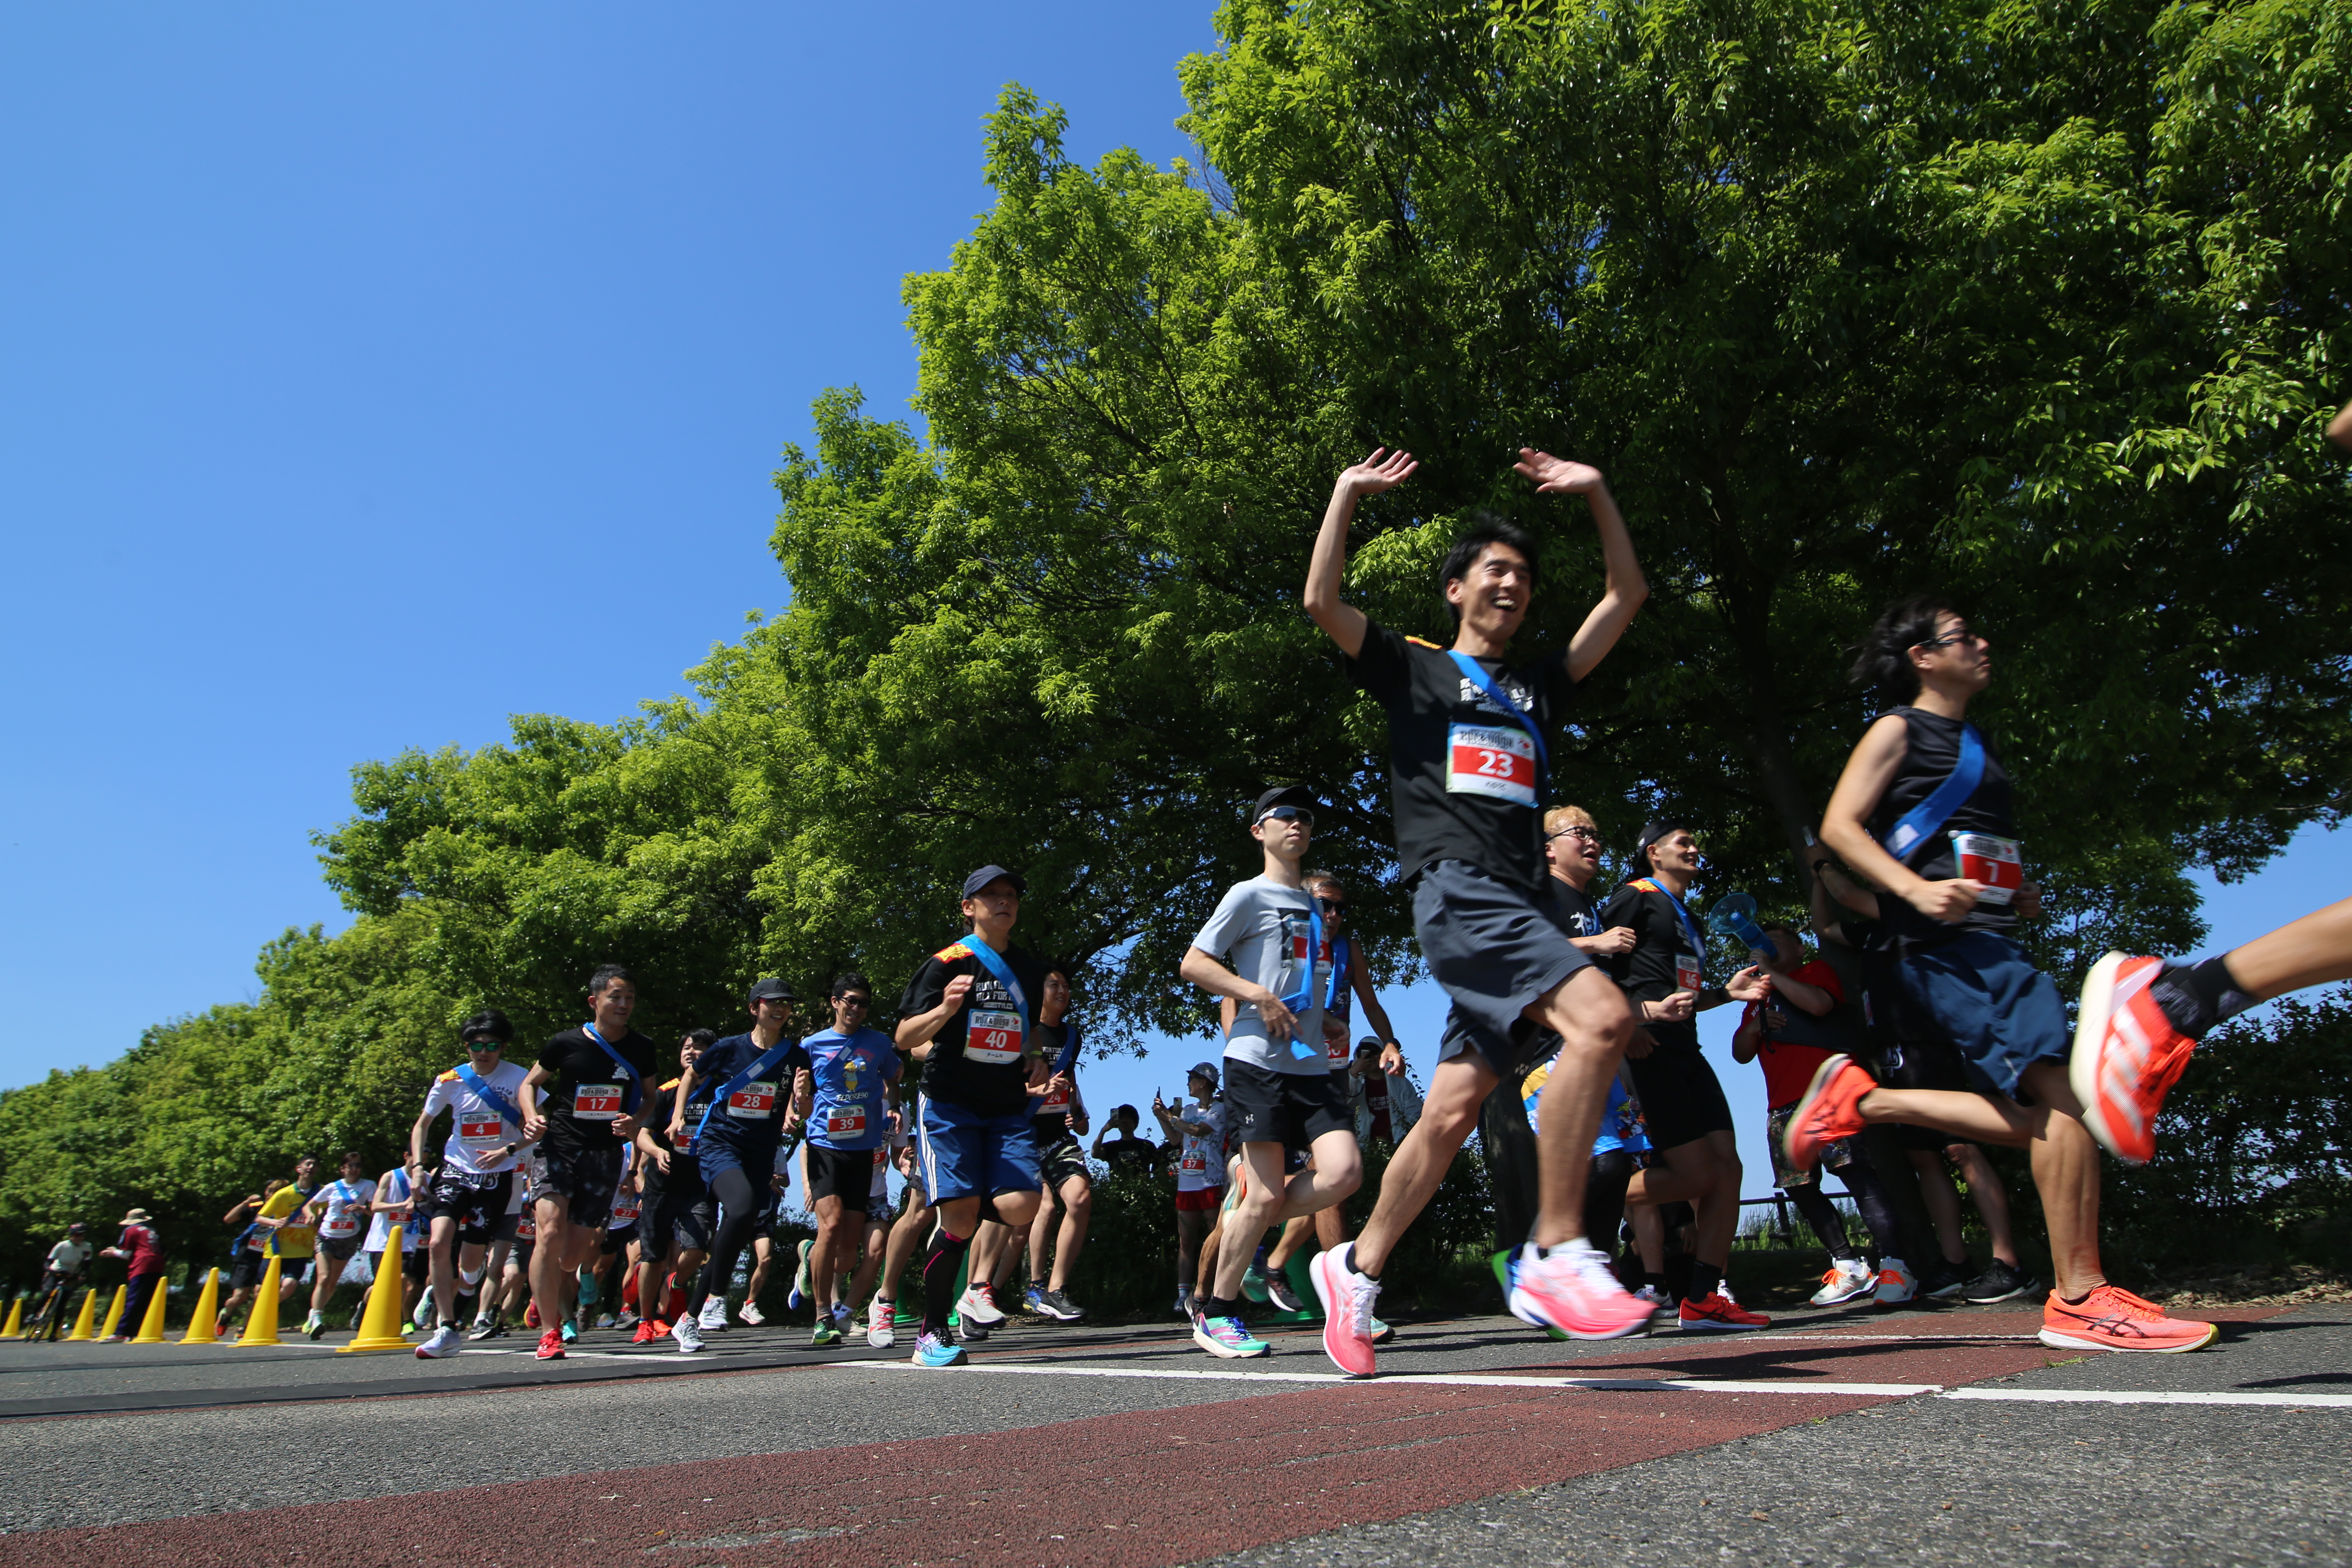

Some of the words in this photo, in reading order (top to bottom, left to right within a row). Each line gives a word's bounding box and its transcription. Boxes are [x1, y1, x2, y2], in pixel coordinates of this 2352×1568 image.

[1477, 751, 1514, 777] 23
[1985, 862, 1998, 882] 7
[976, 981, 993, 991] RUN
[993, 980, 1005, 989] FO
[1685, 973, 1697, 988] 46
[993, 991, 1007, 1000] FOR
[984, 1031, 1007, 1048] 40
[742, 1095, 761, 1107] 28
[836, 1092, 869, 1102] ELDORESO
[1047, 1094, 1061, 1103] 24
[590, 1098, 608, 1109] 17
[476, 1124, 485, 1134] 4
[840, 1118, 854, 1129] 39
[1187, 1160, 1197, 1168] 37
